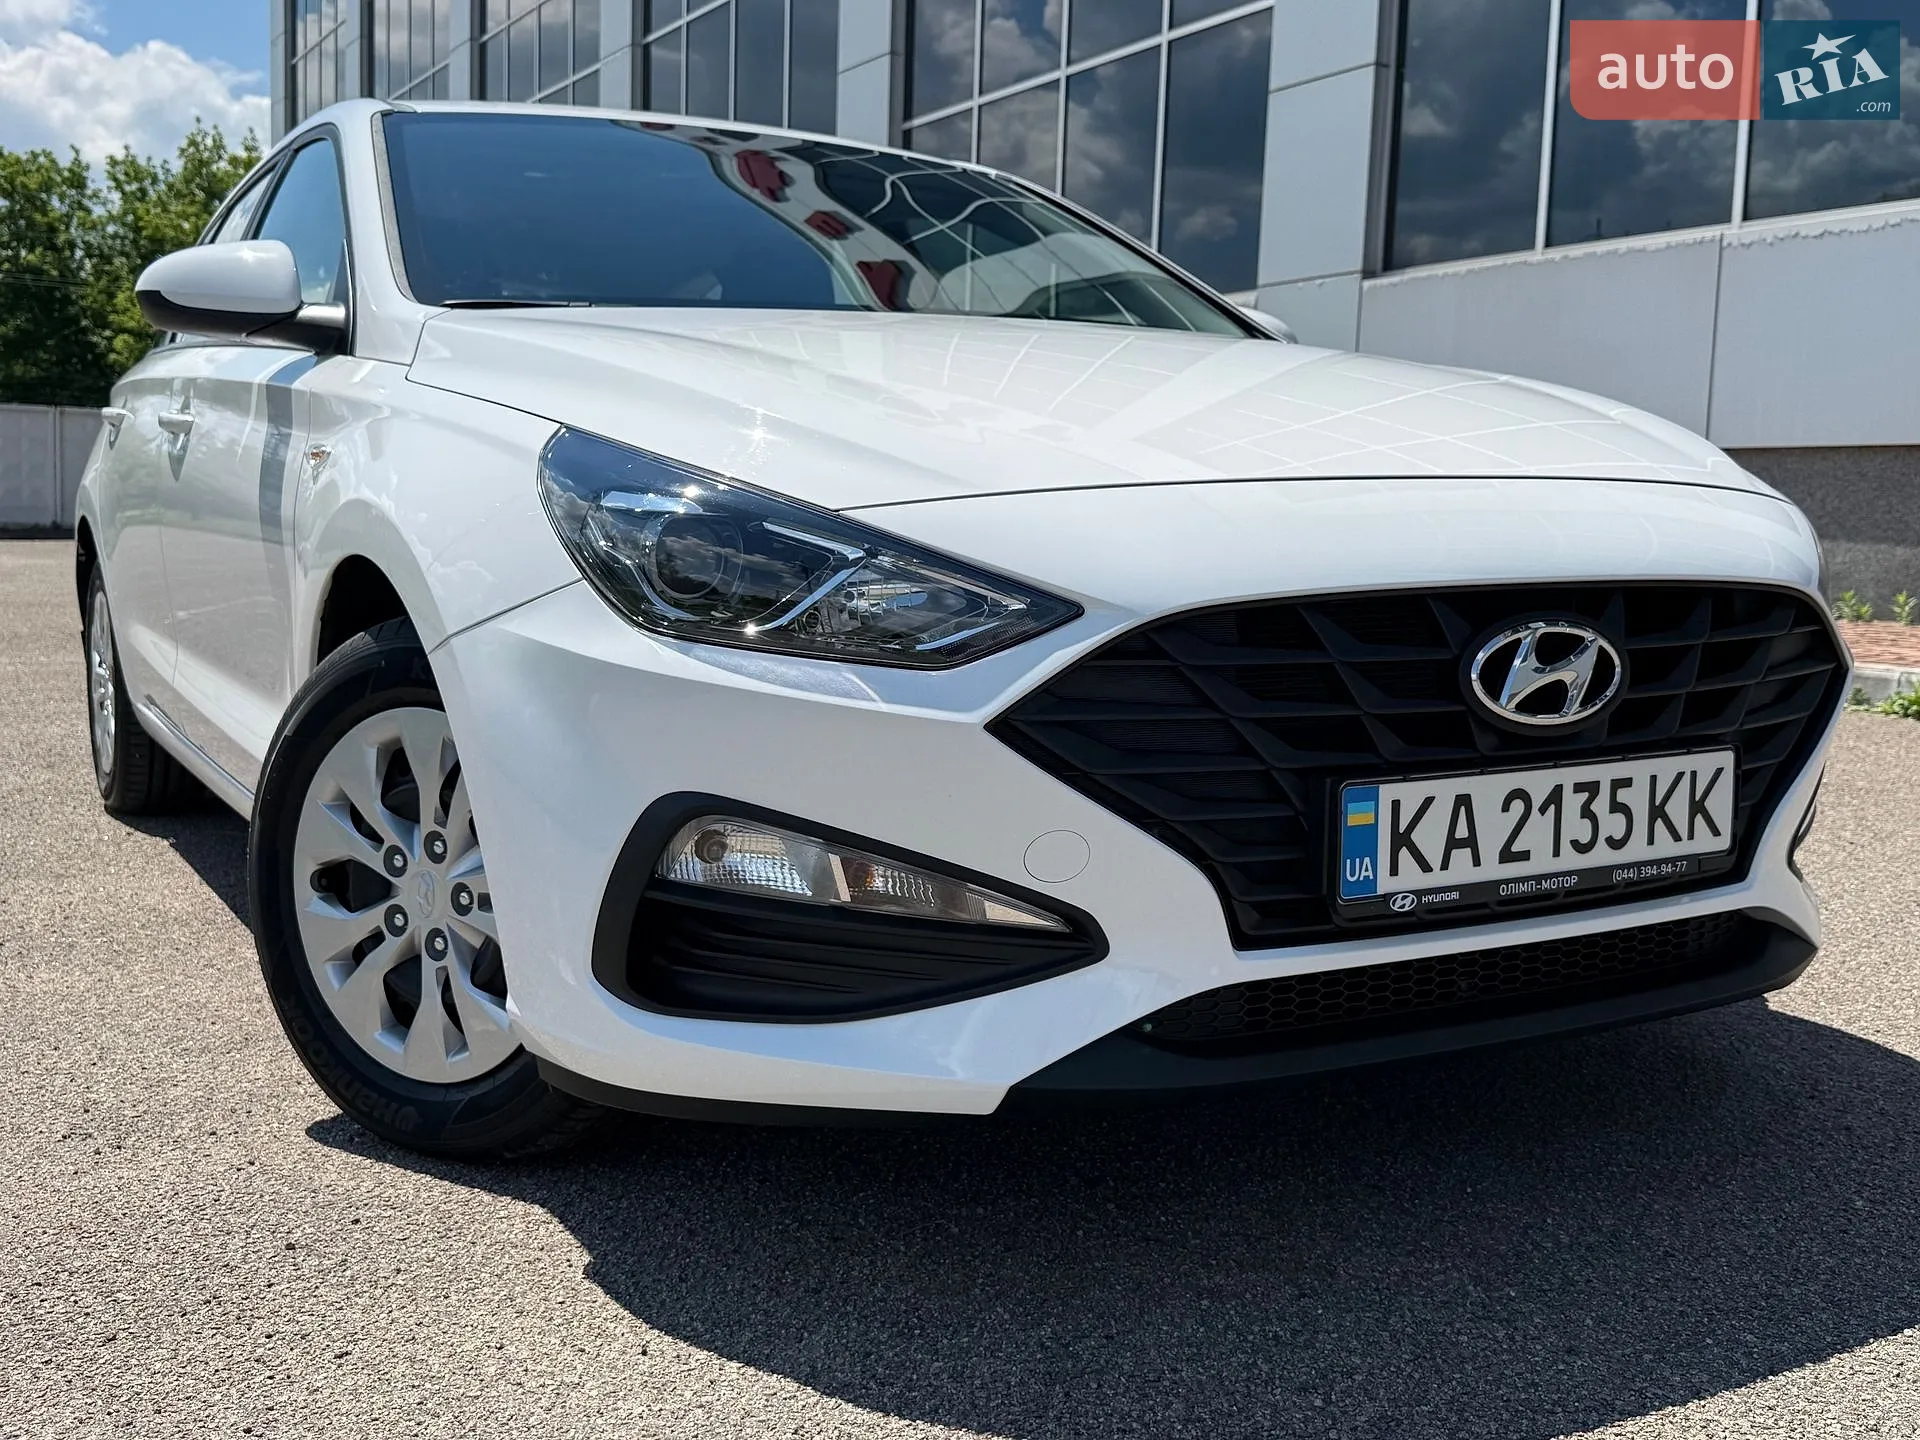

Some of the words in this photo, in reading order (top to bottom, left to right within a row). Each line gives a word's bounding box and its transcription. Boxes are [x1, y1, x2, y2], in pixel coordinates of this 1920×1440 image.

[1498, 777, 1633, 864] 2135
[1345, 855, 1374, 882] UA
[1612, 868, 1637, 883] (044)
[1639, 861, 1687, 877] 394-94-77
[1499, 876, 1578, 896] ОЛІМП-МОТОР
[1421, 891, 1460, 904] HYUNDAI
